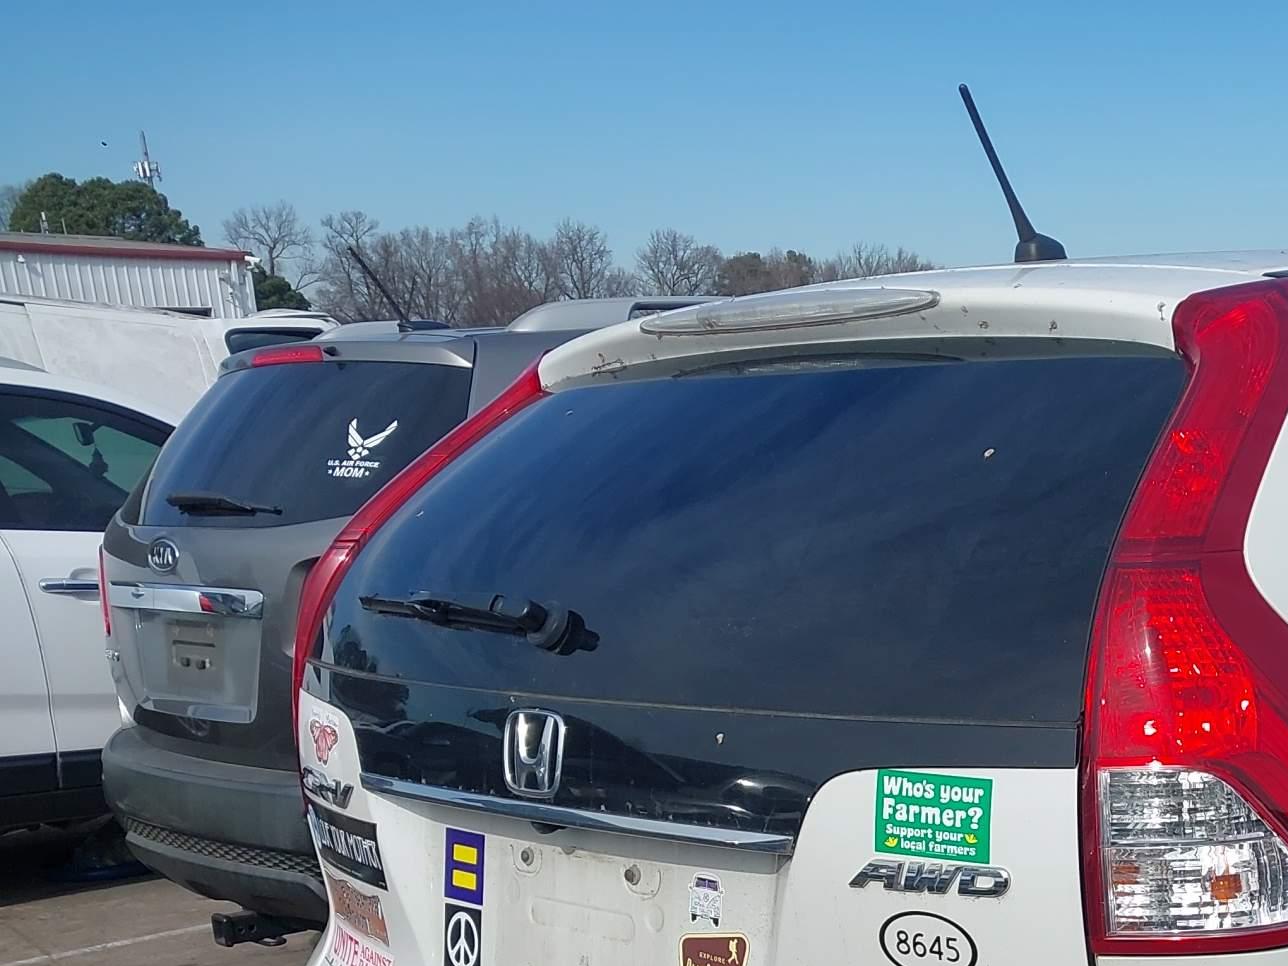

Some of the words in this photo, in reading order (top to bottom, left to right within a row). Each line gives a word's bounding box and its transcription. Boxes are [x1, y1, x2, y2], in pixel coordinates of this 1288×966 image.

[332, 467, 365, 478] MOM
[354, 460, 380, 468] FORCE
[152, 547, 174, 565] KIA
[883, 775, 935, 799] Who's
[939, 784, 985, 804] your
[882, 797, 983, 830] Farmer?
[885, 823, 933, 839] Support
[935, 831, 964, 842] your
[900, 838, 926, 851] local
[928, 841, 977, 856] farmers
[848, 859, 1012, 898] AWD
[896, 930, 960, 963] 8645
[699, 951, 726, 965] EXPLORE
